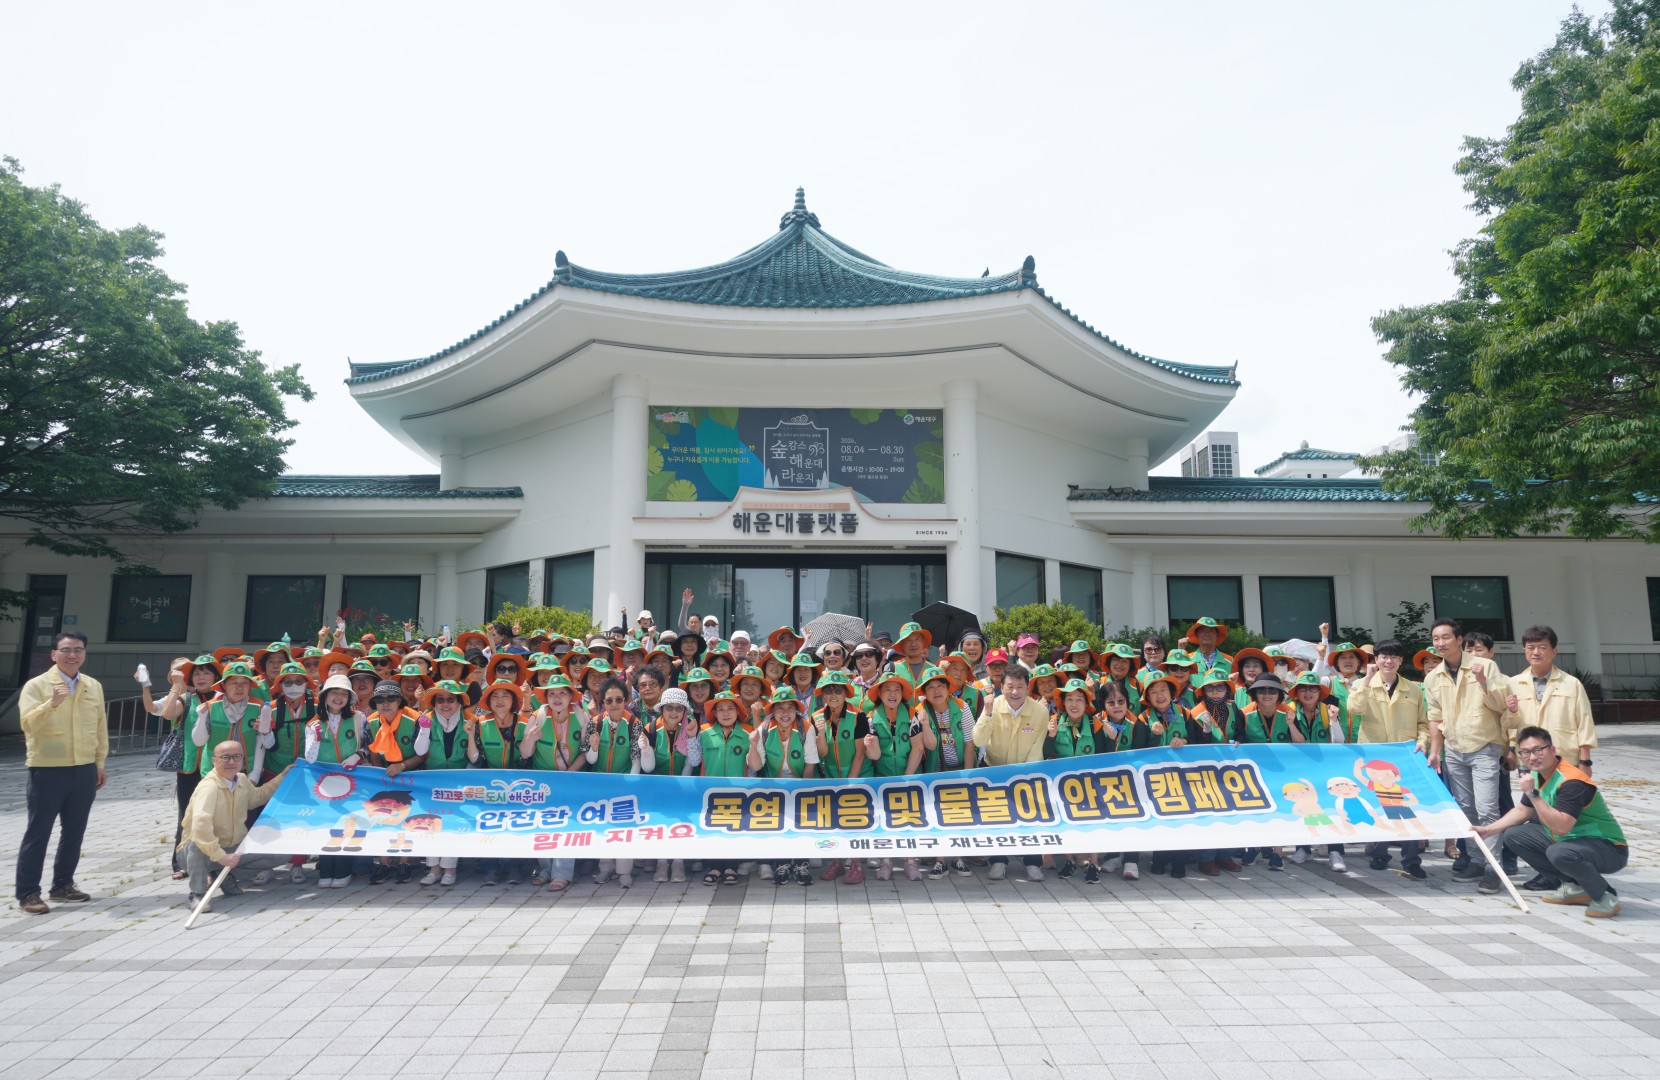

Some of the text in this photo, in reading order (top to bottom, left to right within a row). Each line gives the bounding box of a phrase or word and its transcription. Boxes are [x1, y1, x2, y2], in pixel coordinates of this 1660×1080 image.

[840, 445, 865, 454] 08.04
[880, 446, 904, 454] 08.30
[789, 454, 822, 468] 해운대
[782, 468, 814, 484] 라운지
[732, 512, 859, 534] 해운대플랫폼
[433, 786, 544, 804] 최고로 좋은 도시 해운대
[711, 767, 1265, 830] 폭염 대응 및 물놀이 안전 캠페인
[480, 799, 647, 830] 안전한 여름,
[533, 824, 695, 851] 함께 지켜요
[849, 834, 1063, 851] 해운대구 재난안전과
